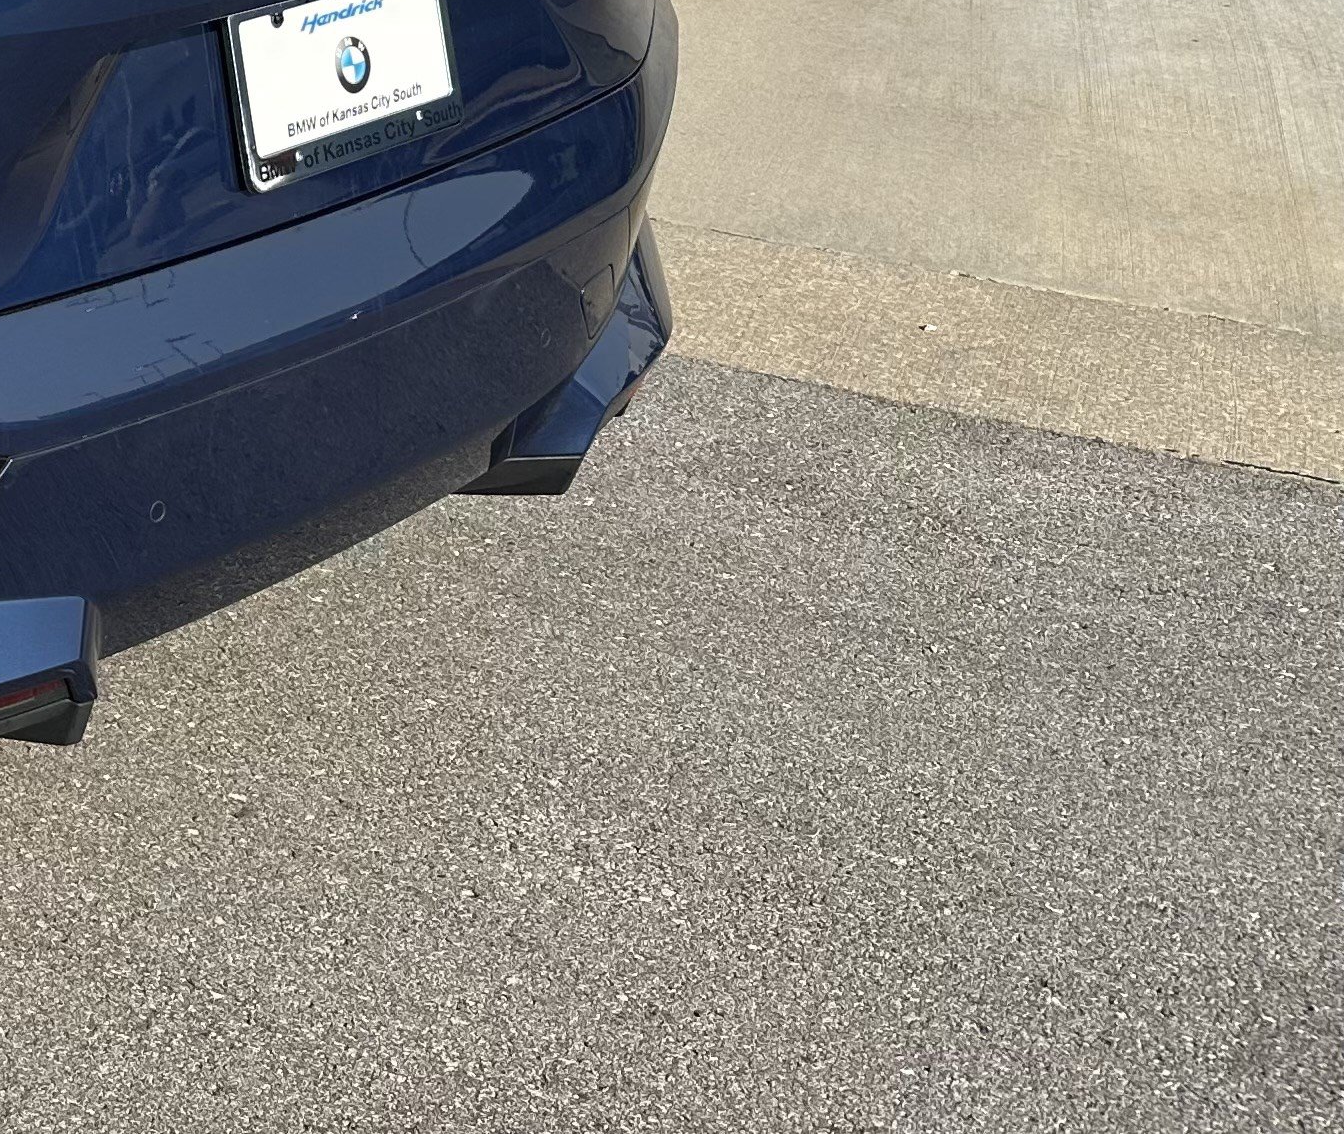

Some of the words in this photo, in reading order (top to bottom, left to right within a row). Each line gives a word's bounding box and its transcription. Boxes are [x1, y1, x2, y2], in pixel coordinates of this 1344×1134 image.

[287, 116, 317, 138] BMW
[319, 111, 330, 126] of
[332, 100, 369, 123] Kansas
[370, 92, 391, 111] City
[393, 82, 422, 103] South
[303, 147, 321, 169] of
[323, 130, 381, 162] Kansas
[384, 118, 416, 141] City
[423, 101, 463, 127] South
